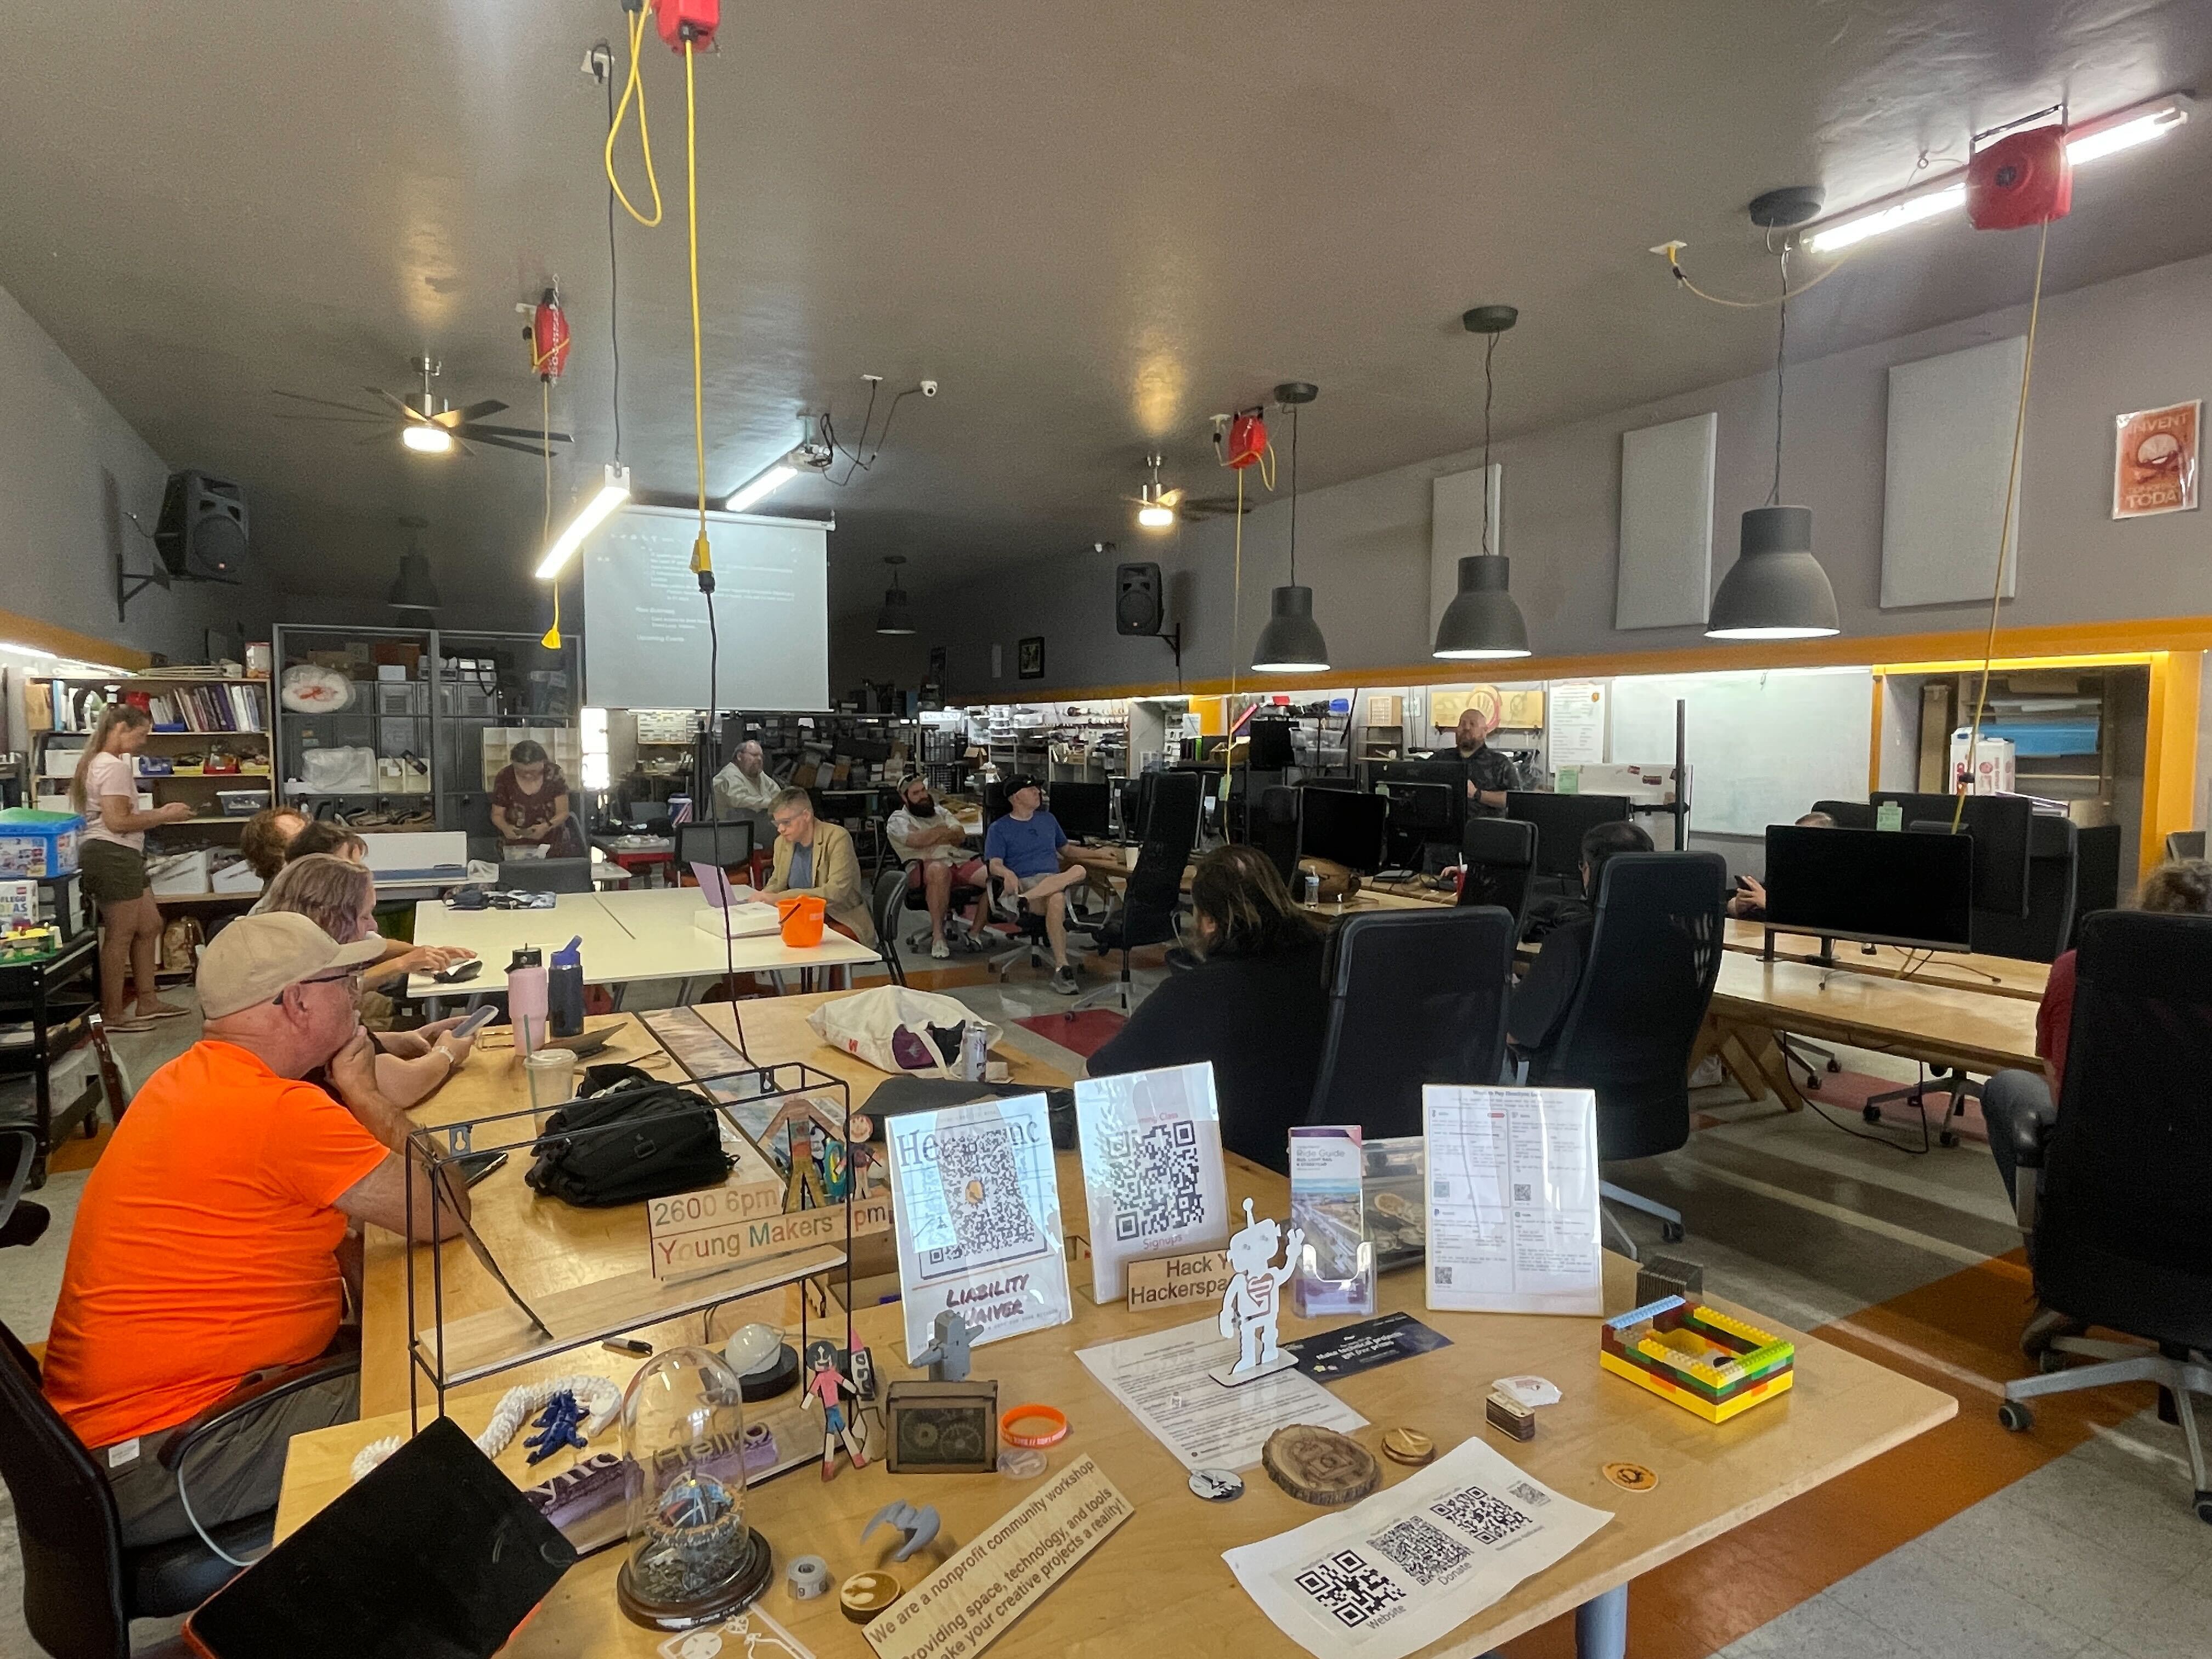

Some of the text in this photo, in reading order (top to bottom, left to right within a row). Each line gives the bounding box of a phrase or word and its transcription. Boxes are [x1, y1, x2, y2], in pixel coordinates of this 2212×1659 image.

[2127, 490, 2180, 508] TODA
[1318, 1149, 1345, 1157] Guide
[654, 1188, 778, 1227] 2600 6pm
[658, 1205, 886, 1265] Young Makers pm
[1142, 1234, 1183, 1251] Signups
[1166, 1255, 1212, 1278] Hack
[946, 1273, 1030, 1308] LIABILITY
[1131, 1278, 1227, 1305] Hackerspa
[653, 1421, 770, 1468] Hello
[868, 1459, 1095, 1643] We are a nonprofit community workshop
[901, 1488, 1113, 1659] roviding space, technology, and tools
[938, 1499, 1126, 1659] ake your creative projects a reality!
[1437, 1561, 1472, 1585] Donate
[1366, 1604, 1407, 1629] Website
